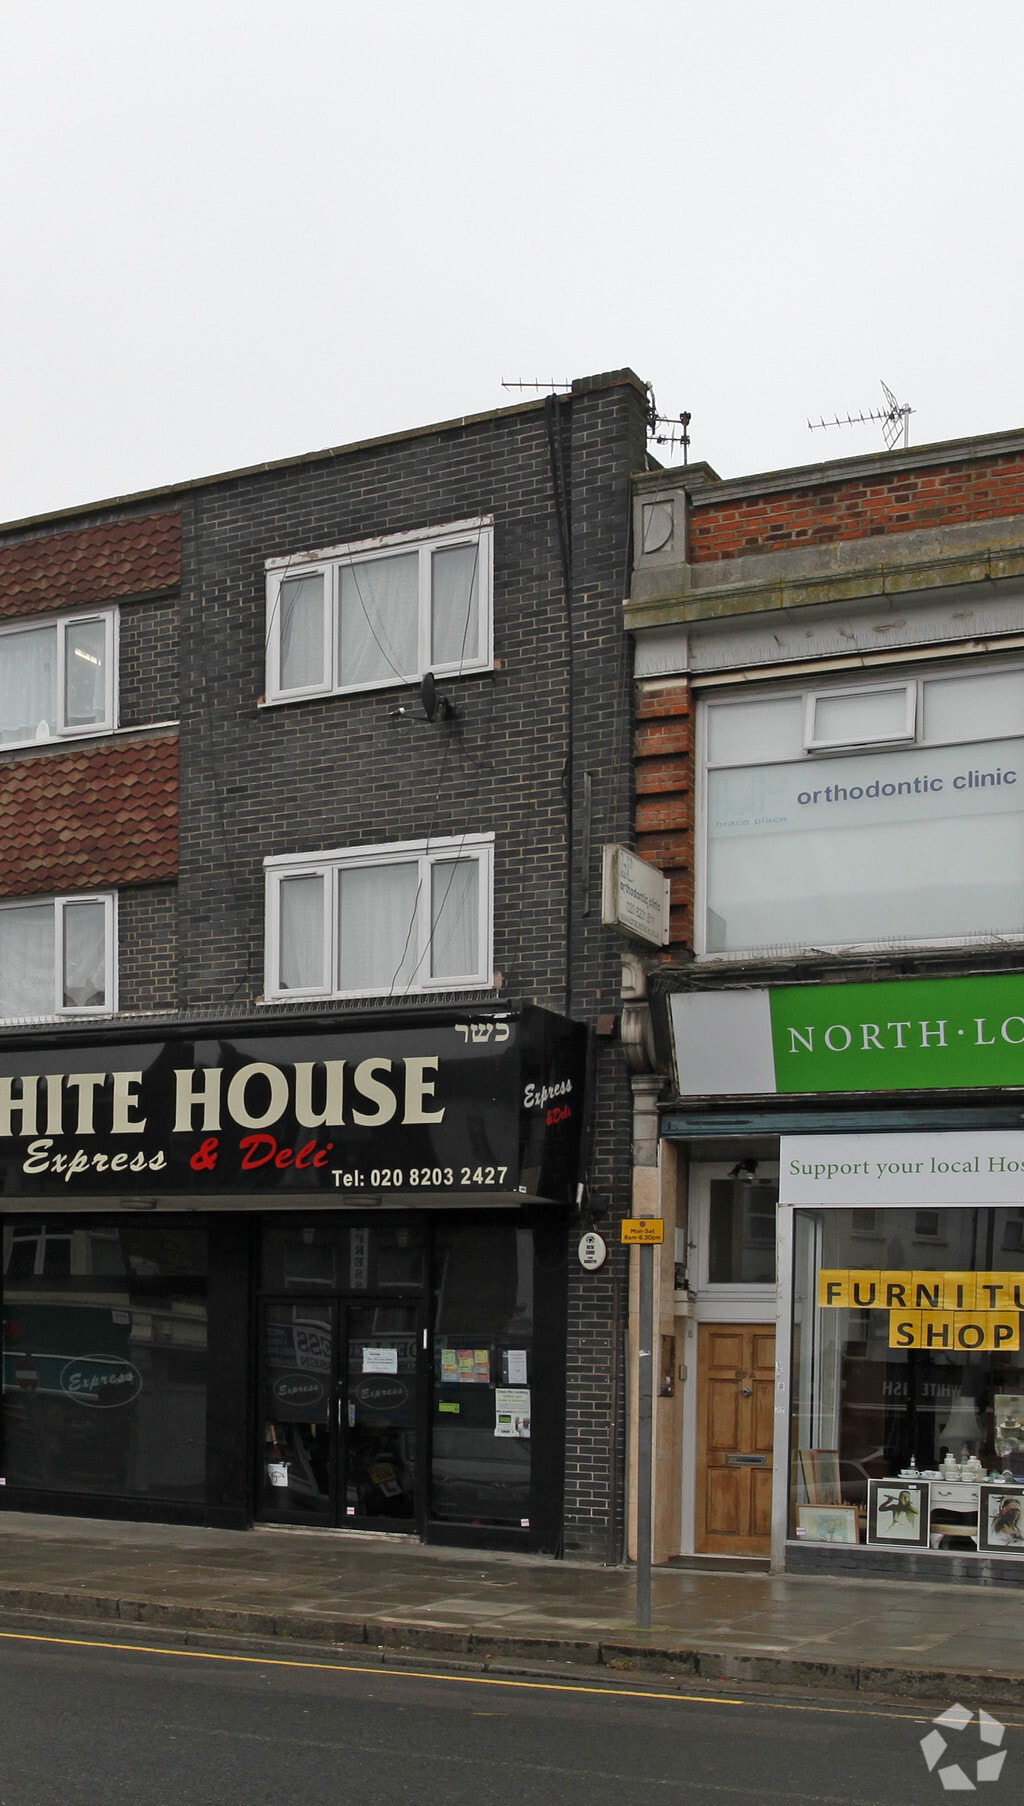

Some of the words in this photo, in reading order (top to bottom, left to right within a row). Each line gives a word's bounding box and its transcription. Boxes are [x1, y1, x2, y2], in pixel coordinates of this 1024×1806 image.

[797, 775, 943, 805] orthodontic
[952, 767, 1017, 790] clinic
[715, 819, 750, 828] brace
[754, 815, 787, 826] place
[453, 1021, 510, 1043] כשר
[172, 1056, 446, 1134] HOUSE
[523, 1078, 573, 1109] Express
[22, 1138, 168, 1183] Express
[189, 1138, 219, 1171] &
[238, 1133, 335, 1171] Deli
[789, 1159, 870, 1180] Support
[876, 1162, 924, 1179] your
[930, 1156, 980, 1174] local
[331, 1170, 365, 1187] Tel:
[370, 1169, 403, 1187] 020
[409, 1168, 456, 1186] 8203
[461, 1167, 509, 1185] 2427
[896, 1322, 1014, 1349] SHOP
[69, 1371, 134, 1391] Express
[278, 1383, 319, 1397] Express
[360, 1387, 403, 1400] Express
